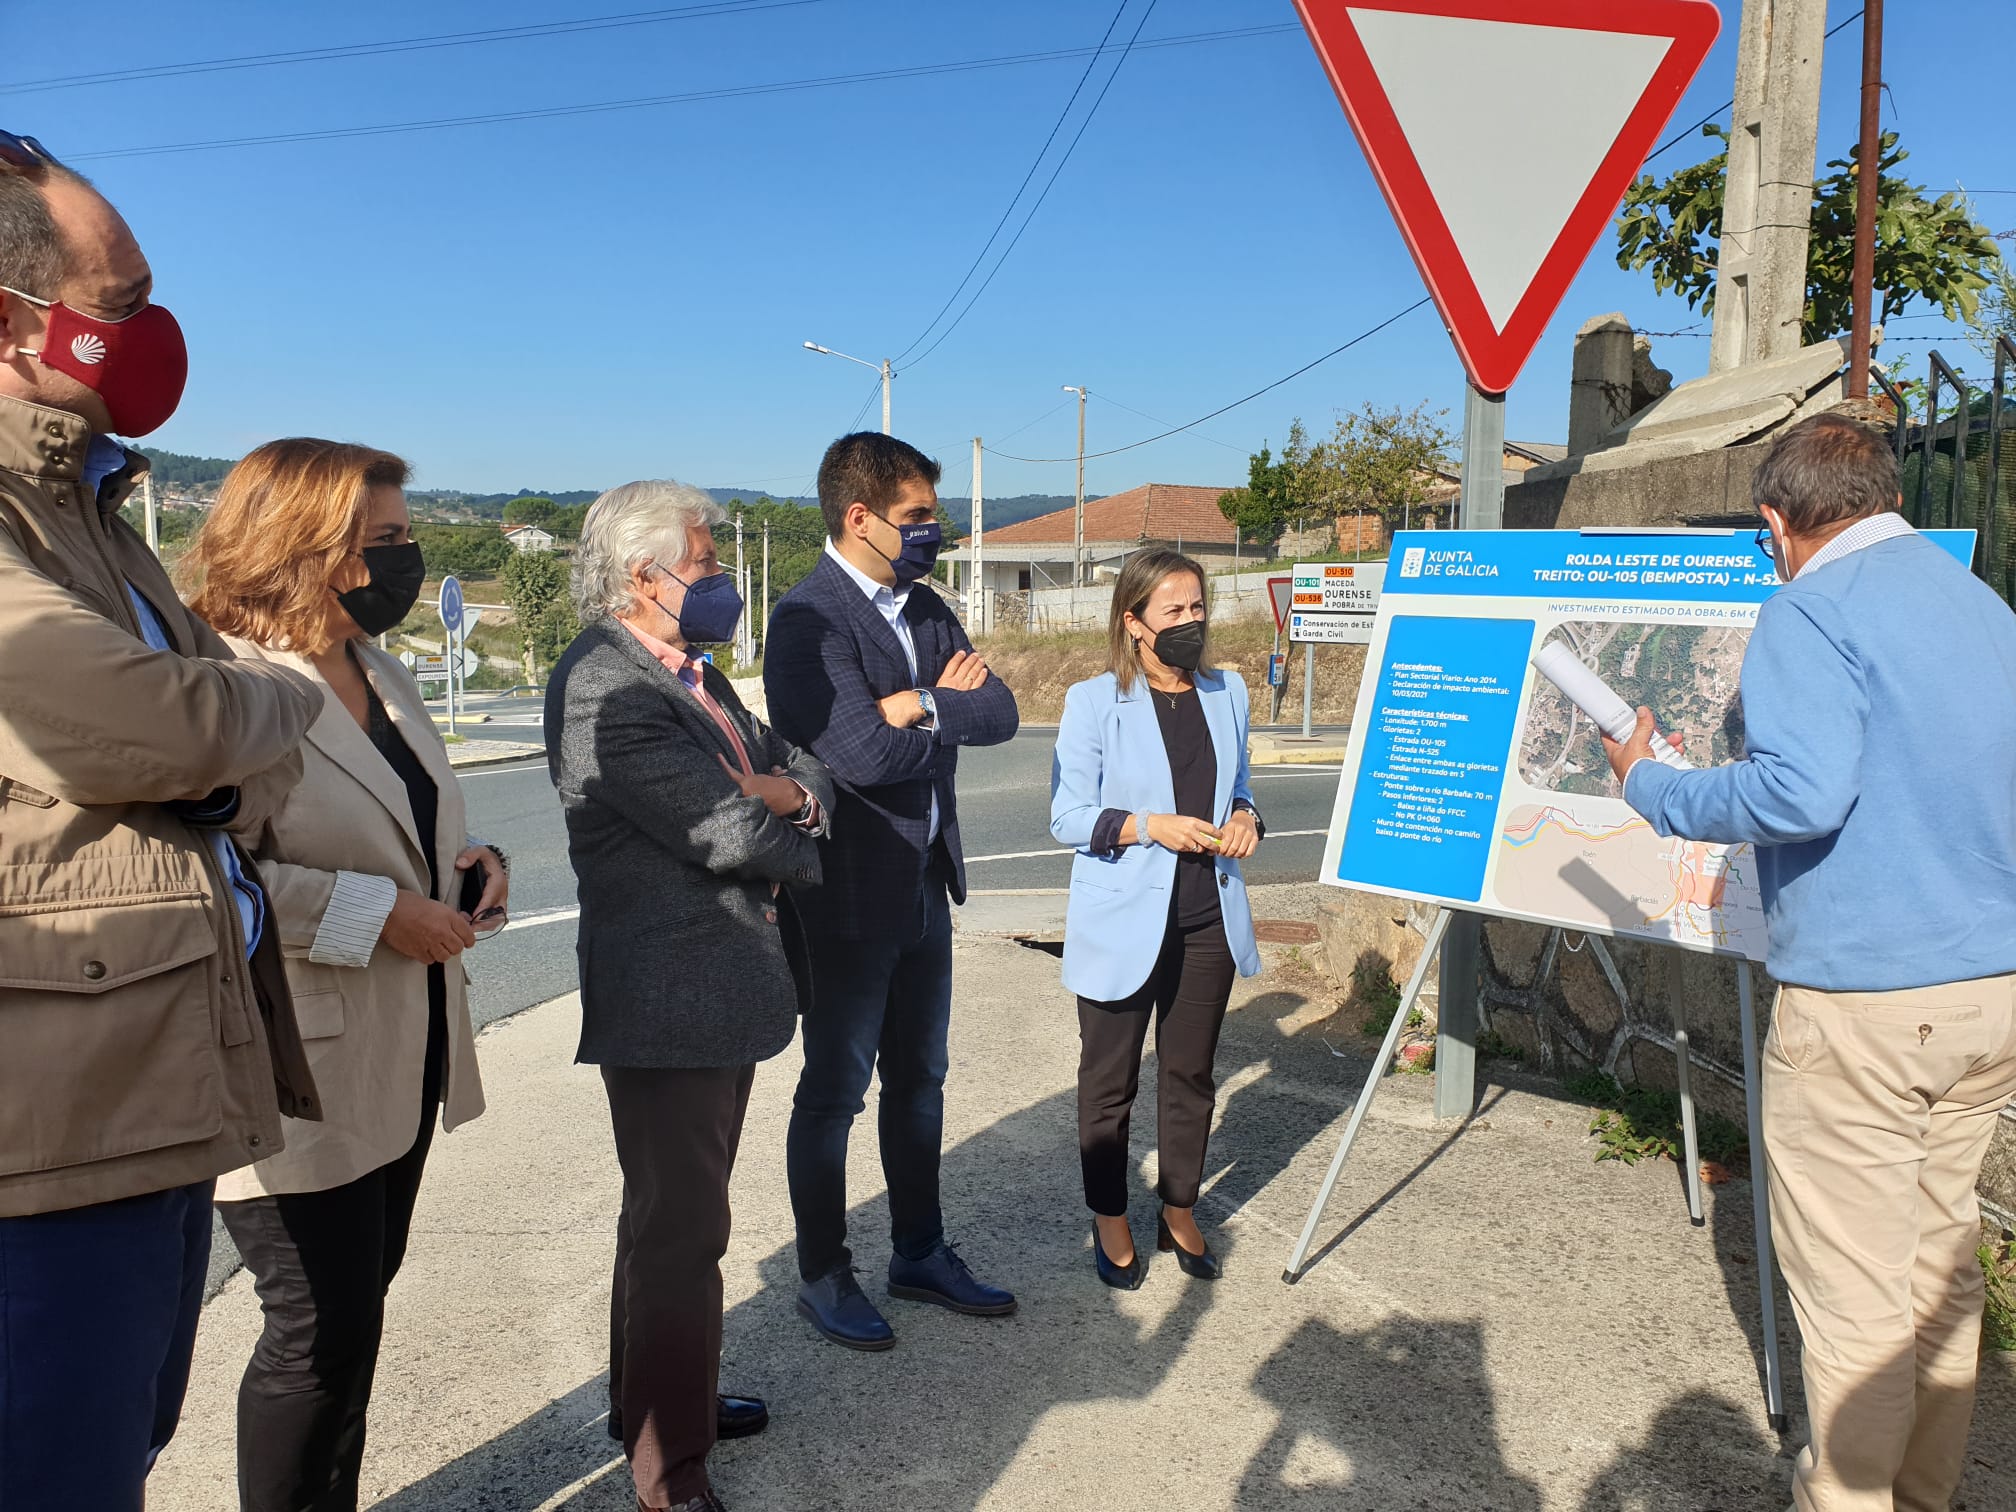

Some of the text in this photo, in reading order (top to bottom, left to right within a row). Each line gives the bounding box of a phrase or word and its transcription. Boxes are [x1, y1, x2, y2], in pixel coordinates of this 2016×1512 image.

[1427, 550, 1473, 563] XUNTA
[1566, 553, 1756, 569] ROLDA LESTE DE OURENSE.
[1326, 568, 1353, 576] OU-510
[1424, 564, 1499, 577] DE GALICIA
[1533, 569, 1584, 582] TREITO:
[1587, 570, 1638, 583] OU-105
[1640, 571, 1730, 587] (BEMPOSTA)
[1743, 573, 1785, 586] N-52
[1325, 589, 1372, 599] OURENSE
[1332, 601, 1356, 609] POBRA
[1548, 603, 1757, 619] INVESTIMENTO ESTIMADO DA OBRA: 6M €
[1303, 619, 1349, 628] Conservación
[1303, 629, 1344, 638] Garda Civil
[1392, 662, 1444, 673] Antecedentes:
[1395, 671, 1409, 679] Plan
[1410, 672, 1440, 681] Sectorial
[1441, 674, 1463, 683] Viario:
[1479, 676, 1497, 684] 2014
[1392, 680, 1431, 690] Declaración
[1432, 682, 1442, 690] de
[1442, 684, 1470, 693] impacto
[1382, 707, 1434, 718] Características
[1383, 726, 1415, 734] Glorietas:
[1393, 735, 1420, 744] Estrada
[1391, 744, 1418, 754] Estrada
[1389, 753, 1412, 763] Enlace
[1412, 757, 1432, 765] entre
[1432, 759, 1456, 768] ambas
[1466, 762, 1499, 772] glorietas
[1373, 770, 1410, 781] Estruturas:
[1389, 764, 1420, 773] mediante
[1421, 767, 1448, 776] trazado
[1384, 781, 1404, 790] Ponte
[1404, 784, 1425, 793] sobre
[1474, 791, 1485, 800] 70
[1485, 793, 1494, 801] m
[1382, 790, 1445, 805] Pasos inferiores: 2
[1397, 801, 1416, 811] Baixo
[1436, 807, 1447, 815] do
[1447, 808, 1467, 818] FFCC
[1395, 811, 1406, 820] No
[1406, 813, 1417, 821] PK
[1376, 818, 1395, 828] Muro
[1395, 820, 1405, 829] de
[1405, 823, 1443, 833] contención
[1444, 828, 1455, 836] no
[1375, 827, 1394, 836] baixo
[1400, 831, 1420, 841] ponte
[1421, 833, 1432, 842] do
